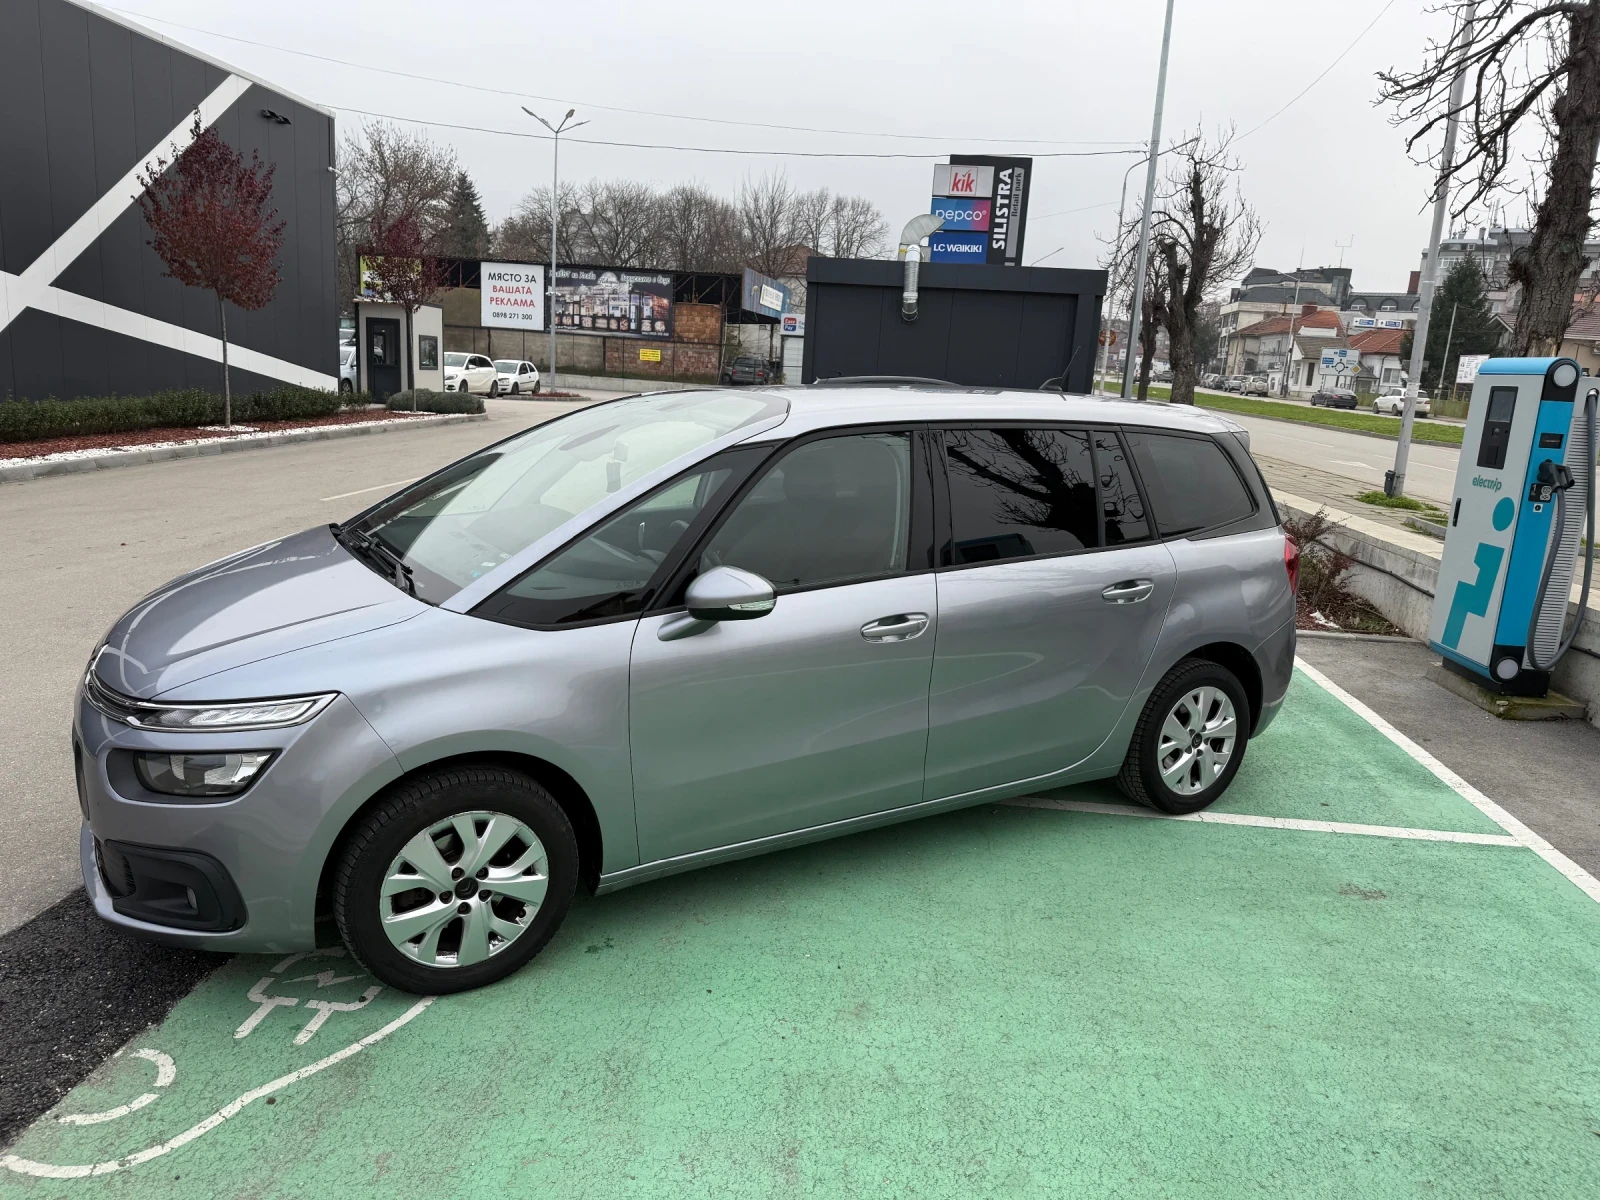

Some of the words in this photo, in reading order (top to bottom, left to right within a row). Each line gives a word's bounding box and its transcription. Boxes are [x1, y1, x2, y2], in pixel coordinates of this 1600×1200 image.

[1014, 172, 1022, 191] park
[992, 168, 1013, 250] SILISTRA
[1011, 194, 1020, 217] Retail
[933, 243, 946, 252] LC
[488, 272, 522, 283] МЯСТО
[524, 274, 537, 284] ЗА
[492, 285, 533, 295] ВАШАТА
[489, 296, 536, 308] РЕКЛАМА
[492, 311, 508, 319] 0898
[1472, 474, 1503, 493] electrip
